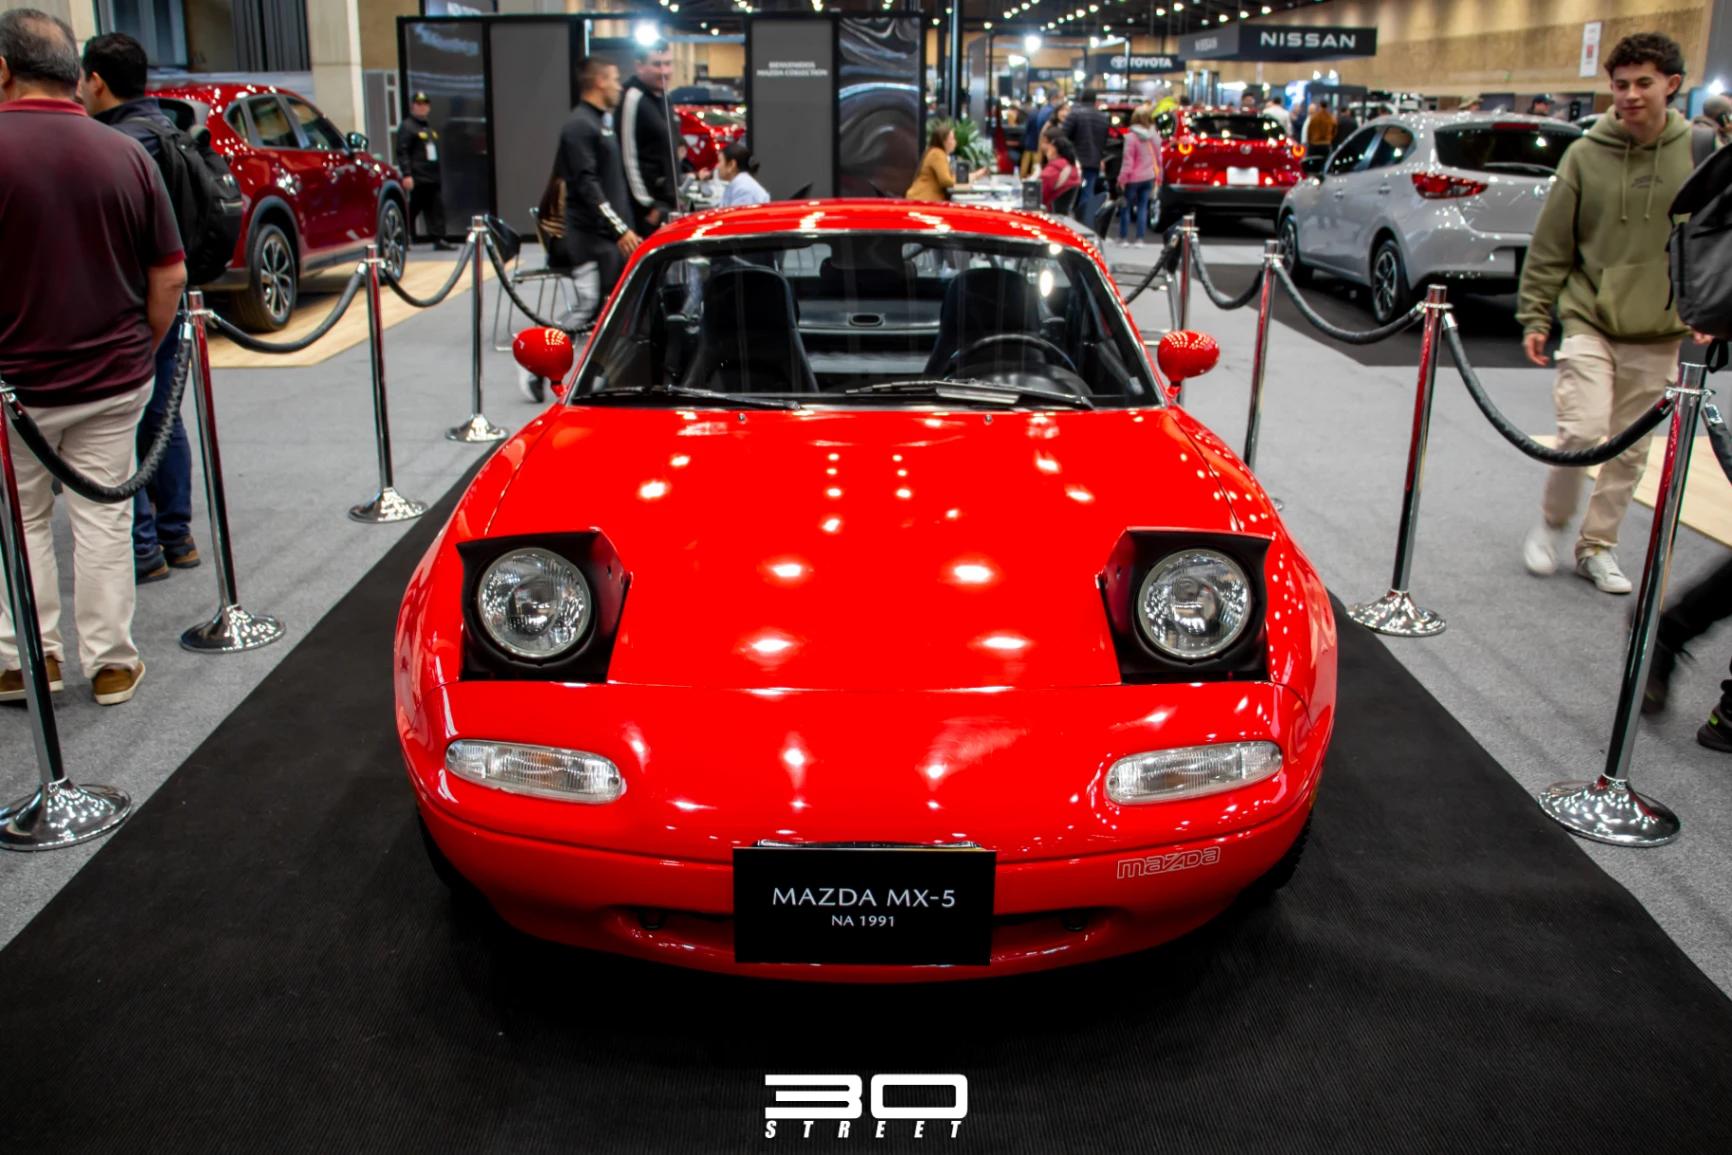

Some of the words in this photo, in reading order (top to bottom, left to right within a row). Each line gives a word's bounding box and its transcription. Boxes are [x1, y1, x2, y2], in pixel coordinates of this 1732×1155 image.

[1260, 32, 1356, 48] NISSAN
[1129, 56, 1172, 69] TOYOTA
[772, 887, 878, 908] MAZDA
[887, 888, 957, 908] MX-5
[831, 914, 855, 927] NA
[859, 914, 896, 927] 1991
